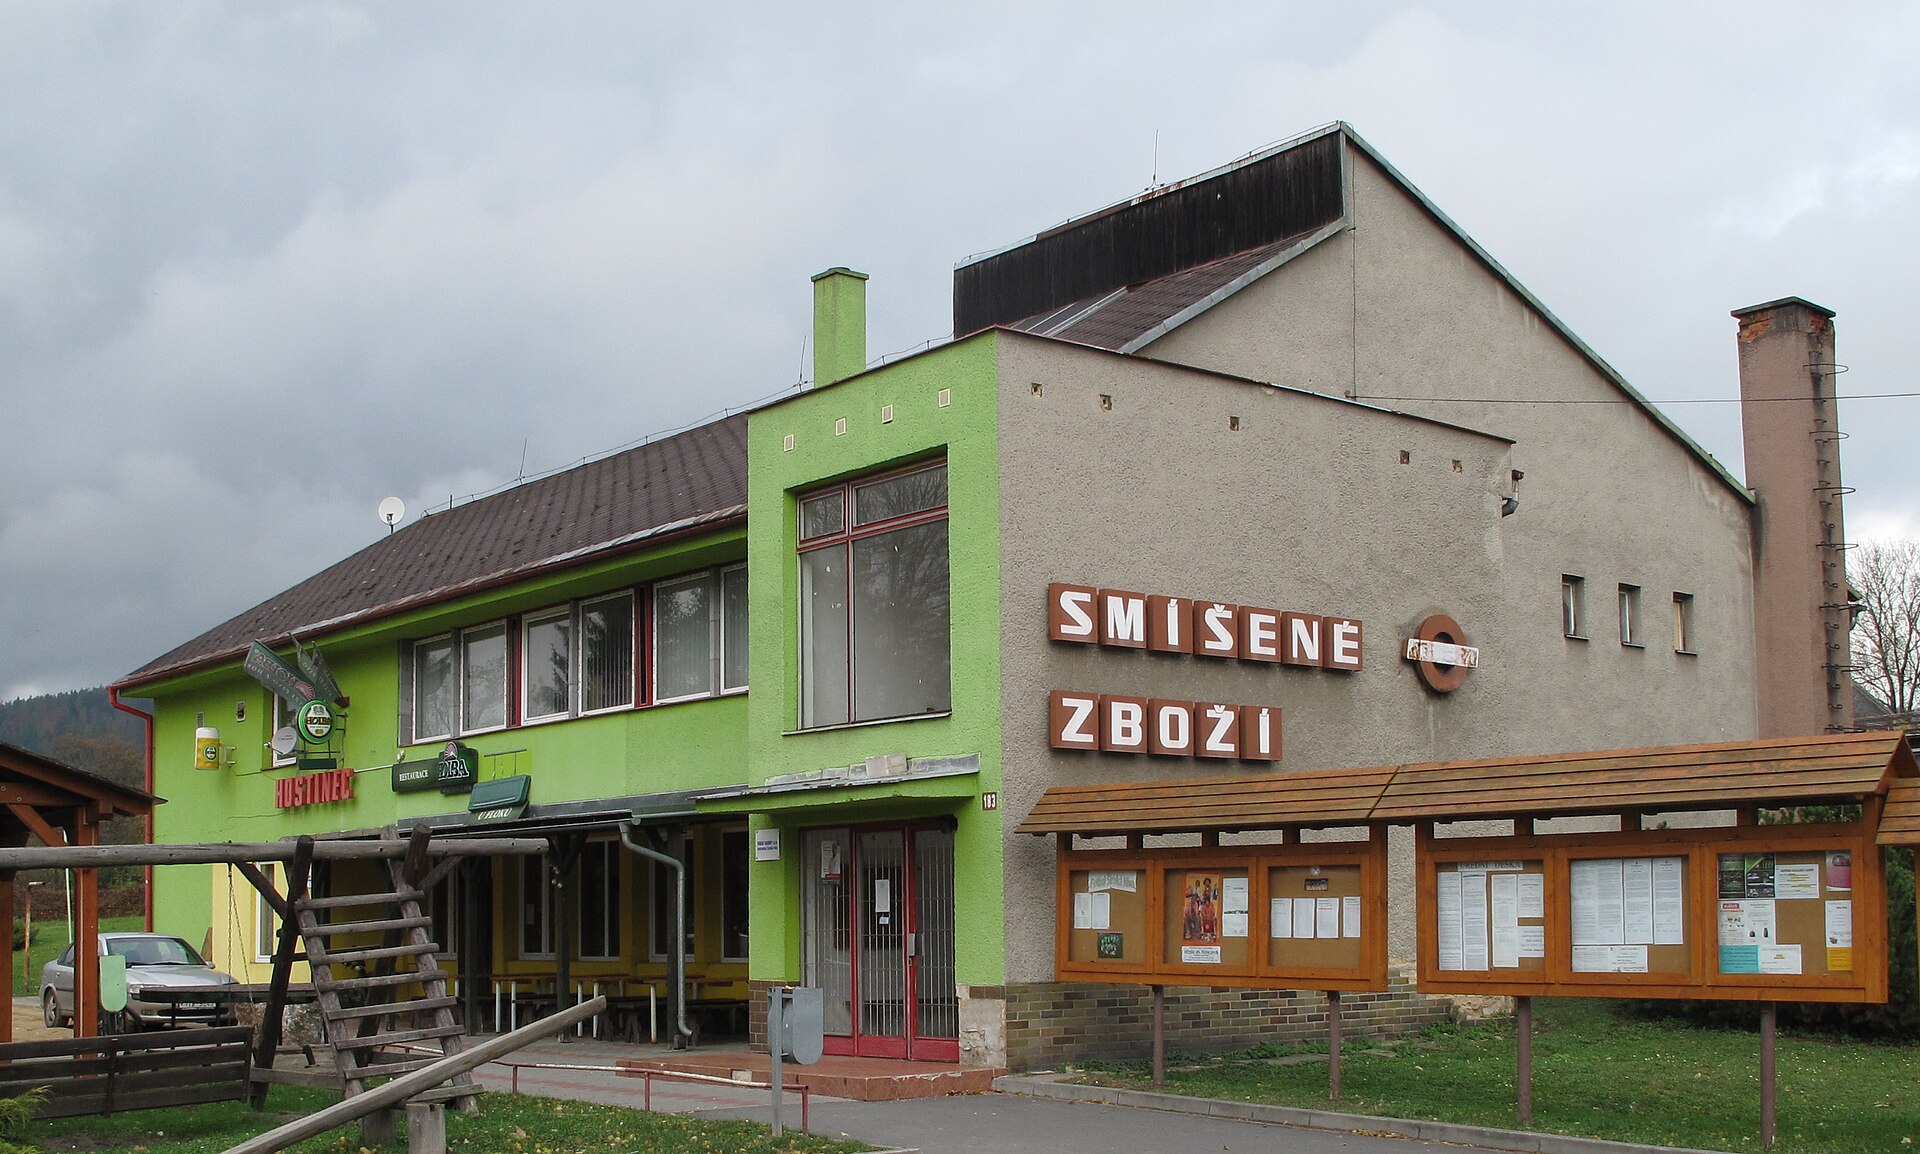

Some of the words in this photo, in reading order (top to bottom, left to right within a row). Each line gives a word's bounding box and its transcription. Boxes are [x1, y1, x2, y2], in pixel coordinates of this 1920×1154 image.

[1060, 590, 1360, 665] SMÍŠENÉ
[1061, 696, 1270, 755] ZBOŽÍ
[274, 768, 354, 809] HOSTINEC
[983, 793, 996, 809] 183
